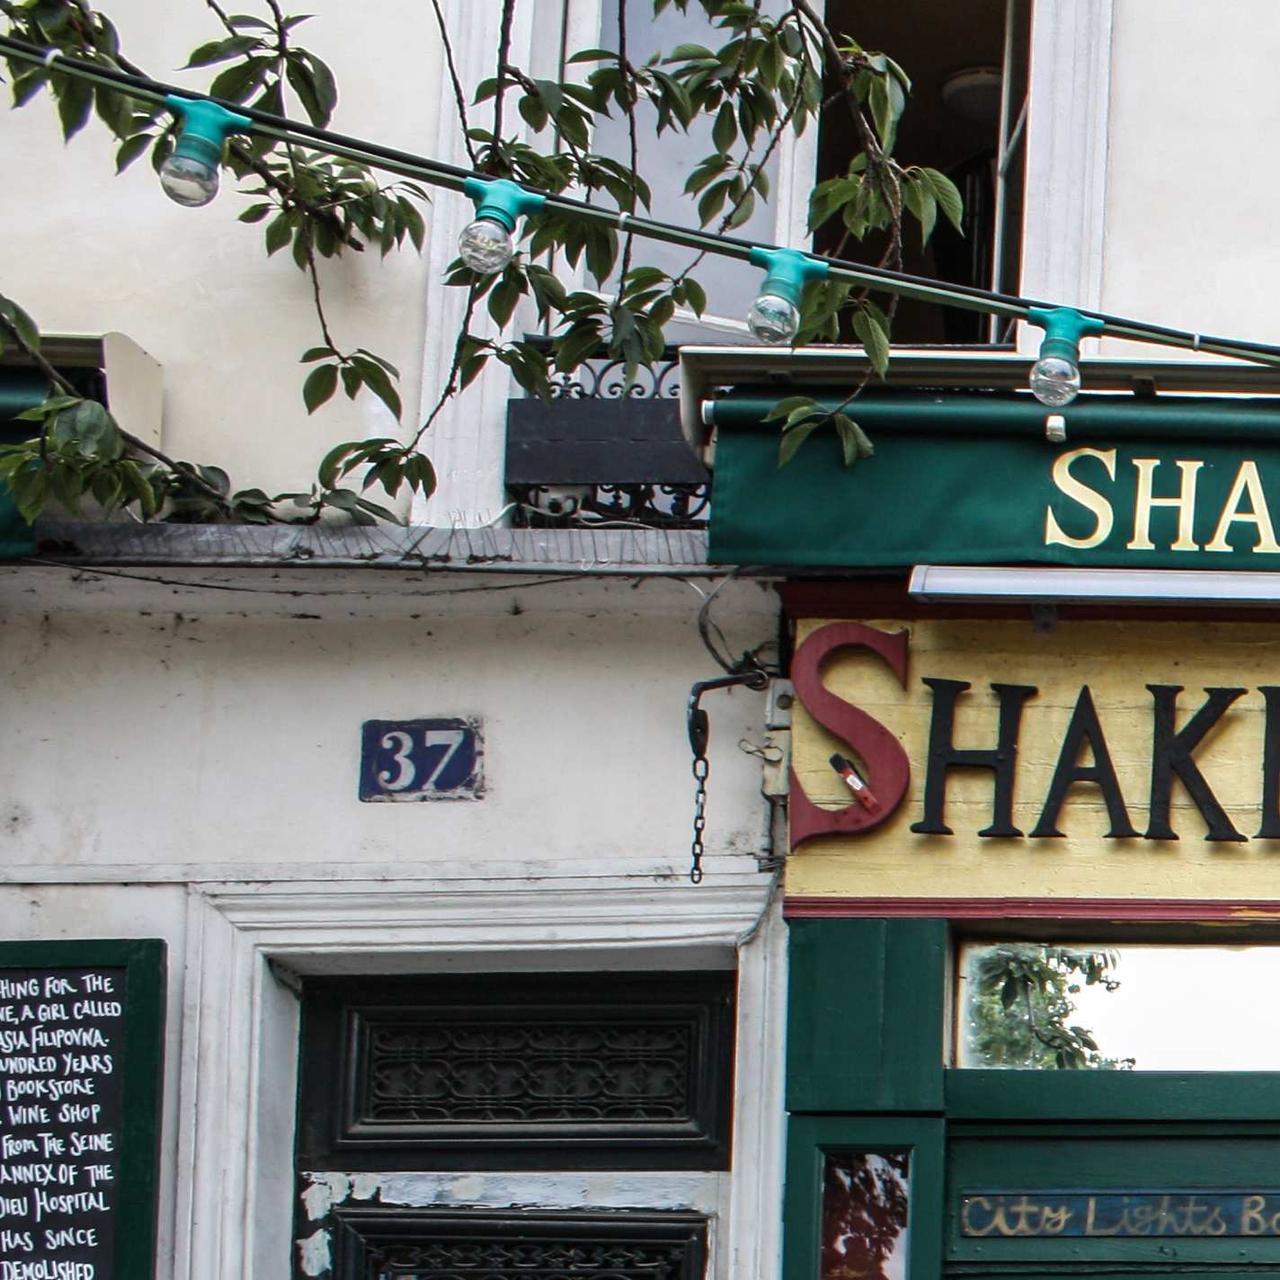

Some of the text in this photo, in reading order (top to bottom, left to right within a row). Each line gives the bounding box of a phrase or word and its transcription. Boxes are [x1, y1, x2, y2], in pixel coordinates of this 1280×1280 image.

[377, 729, 465, 791] 37
[44, 976, 77, 998] FOR
[81, 974, 114, 994] THE
[21, 1000, 122, 1022] A GIRL CALLED
[62, 1053, 113, 1077] YEARS
[6, 1078, 95, 1101] BOOKSTORE
[8, 1103, 101, 1126] WINE SHOP
[37, 1132, 66, 1158] THE
[70, 1132, 114, 1156] SEINE
[58, 1164, 78, 1186] OF
[84, 1164, 114, 1188] THE
[34, 1187, 110, 1222] HOSPITAL
[961, 1194, 1073, 1236] City
[1084, 1195, 1228, 1236] Lights
[1, 1227, 98, 1252] HAS SINCE
